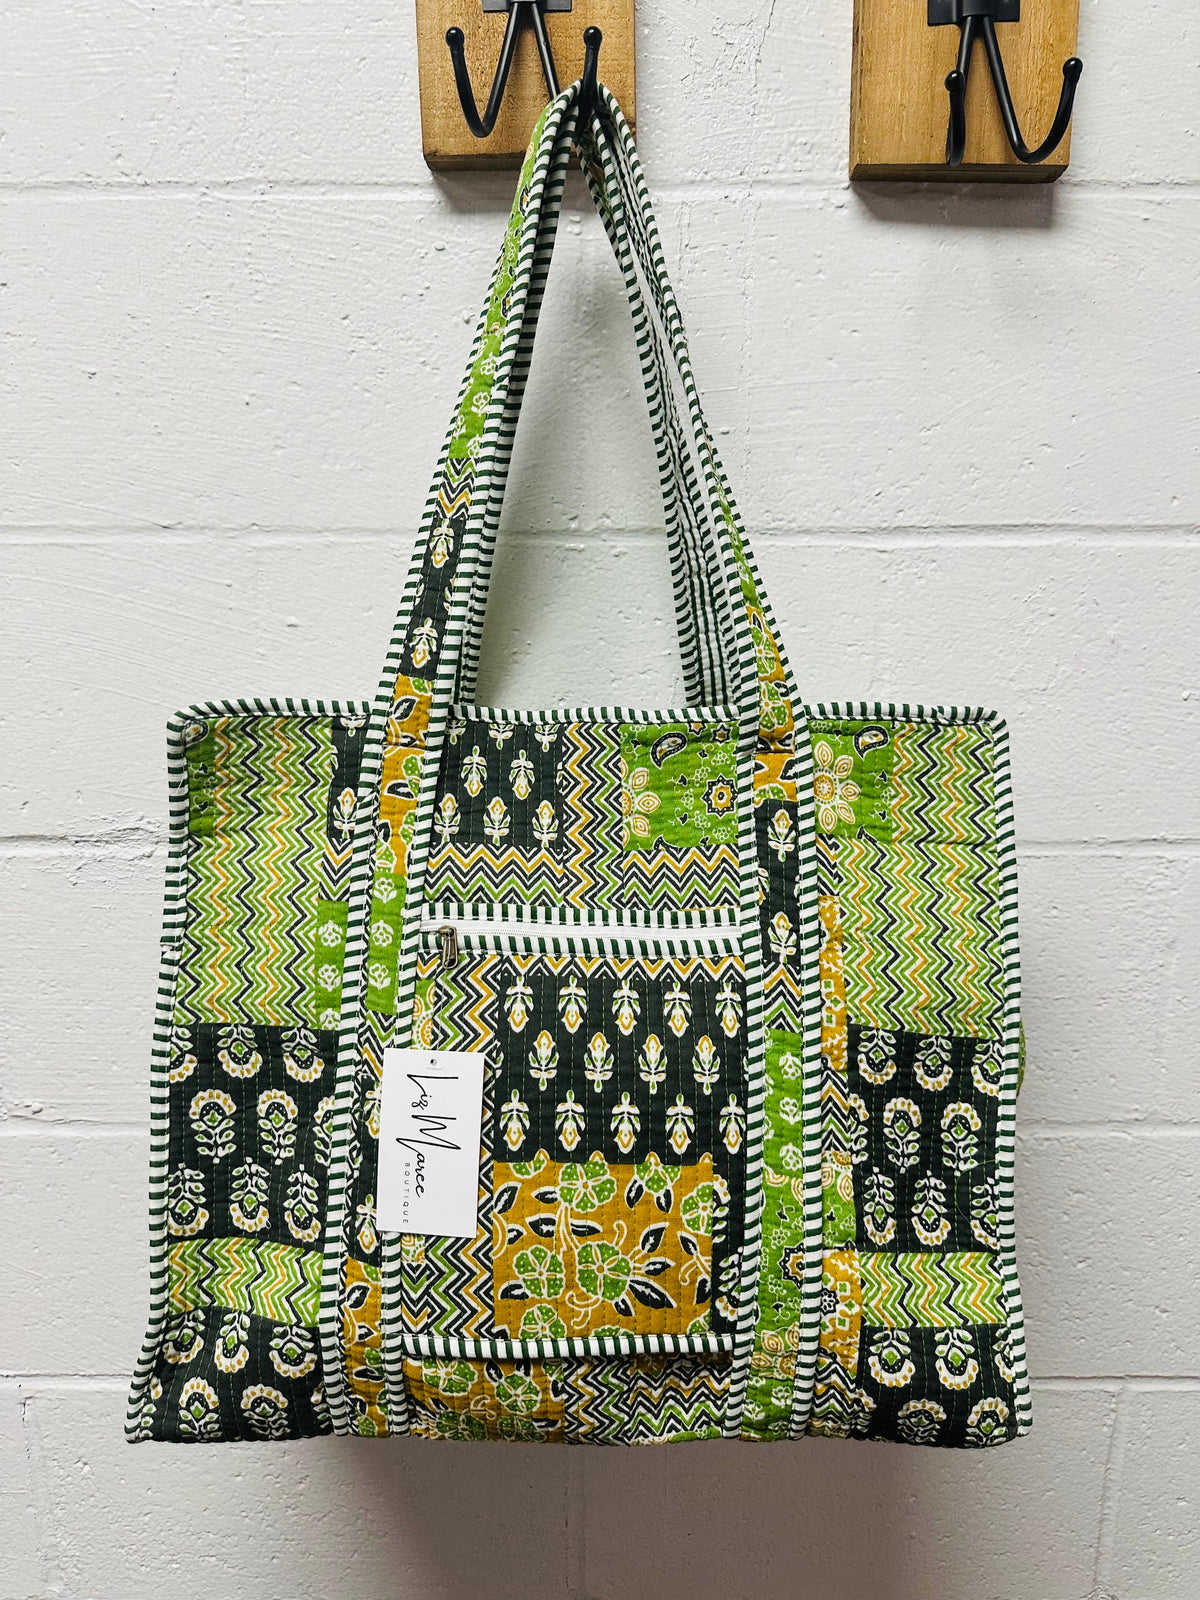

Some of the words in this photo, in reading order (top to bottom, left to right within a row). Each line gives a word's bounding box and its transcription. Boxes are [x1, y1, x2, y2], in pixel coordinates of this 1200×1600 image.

[406, 1074, 459, 1110] Liz
[395, 1115, 462, 1198] Maree
[402, 1162, 411, 1224] BOUTIQUE
